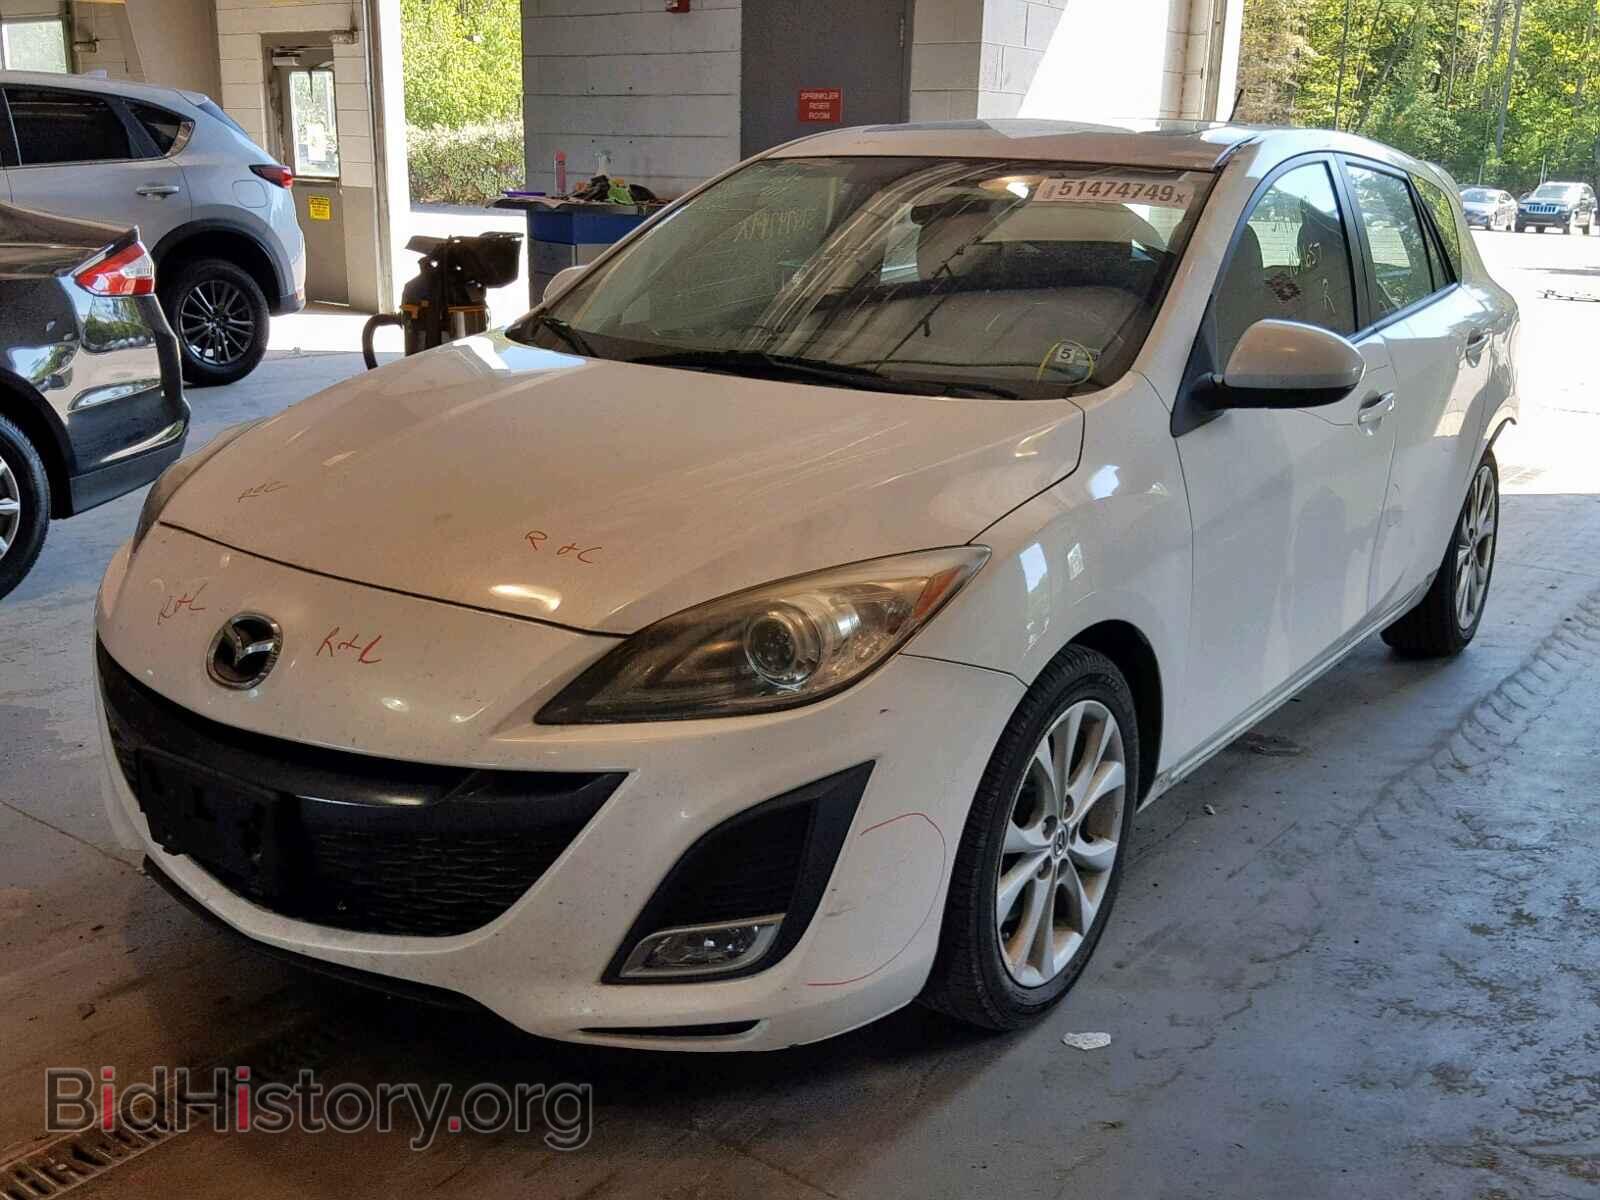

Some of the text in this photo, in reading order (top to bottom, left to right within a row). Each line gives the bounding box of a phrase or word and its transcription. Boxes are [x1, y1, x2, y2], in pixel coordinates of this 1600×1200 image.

[800, 92, 840, 100] SPRINKLER
[809, 102, 830, 110] RISER
[808, 112, 830, 120] ROOM
[1060, 348, 1073, 359] 5
